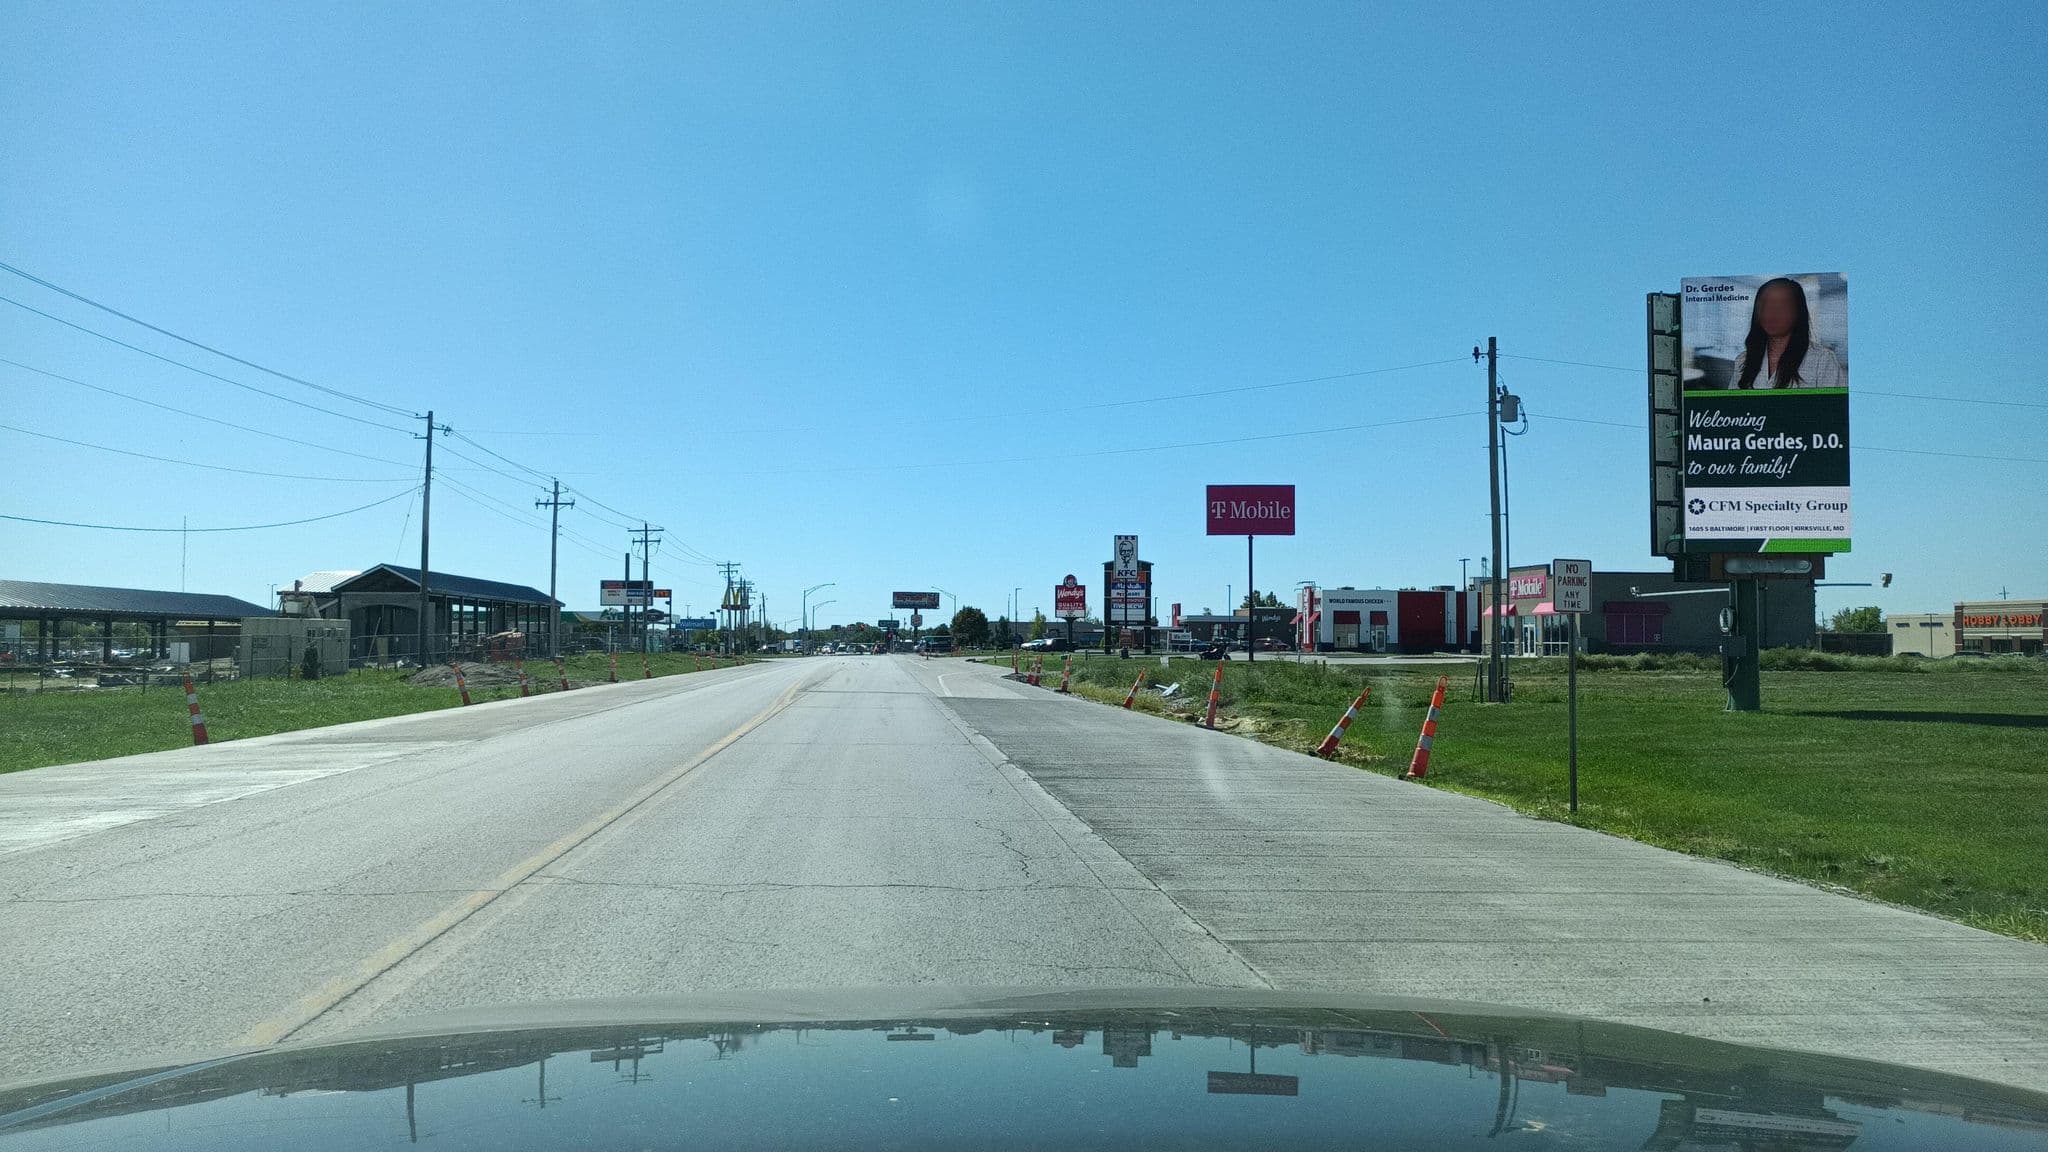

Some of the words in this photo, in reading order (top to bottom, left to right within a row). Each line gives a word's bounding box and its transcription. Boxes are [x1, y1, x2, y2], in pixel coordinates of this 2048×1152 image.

[1685, 284, 1699, 293] Dr.
[1701, 284, 1735, 293] Gerdes
[1716, 294, 1750, 302] Medicine
[1689, 410, 1767, 431] Welcoming
[1687, 434, 1741, 450] Maura
[1745, 432, 1808, 451] Gerdes,
[1812, 433, 1844, 449] D.O.
[1687, 460, 1705, 475] to
[1707, 463, 1737, 475] our
[1739, 454, 1798, 479] family!
[1230, 501, 1291, 519] Mobile
[1709, 500, 1741, 512] CFM
[1745, 500, 1802, 514] Specialty
[1806, 499, 1849, 513] Group
[1566, 564, 1578, 574] NO
[1518, 578, 1543, 595] Mobile
[1558, 576, 1587, 586] PARKING
[1057, 587, 1084, 598] Wendy's
[1565, 590, 1579, 599] ANY
[1564, 600, 1581, 608] TIME
[1963, 615, 1999, 625] HOBBY
[2001, 614, 2041, 625] LOBBY
